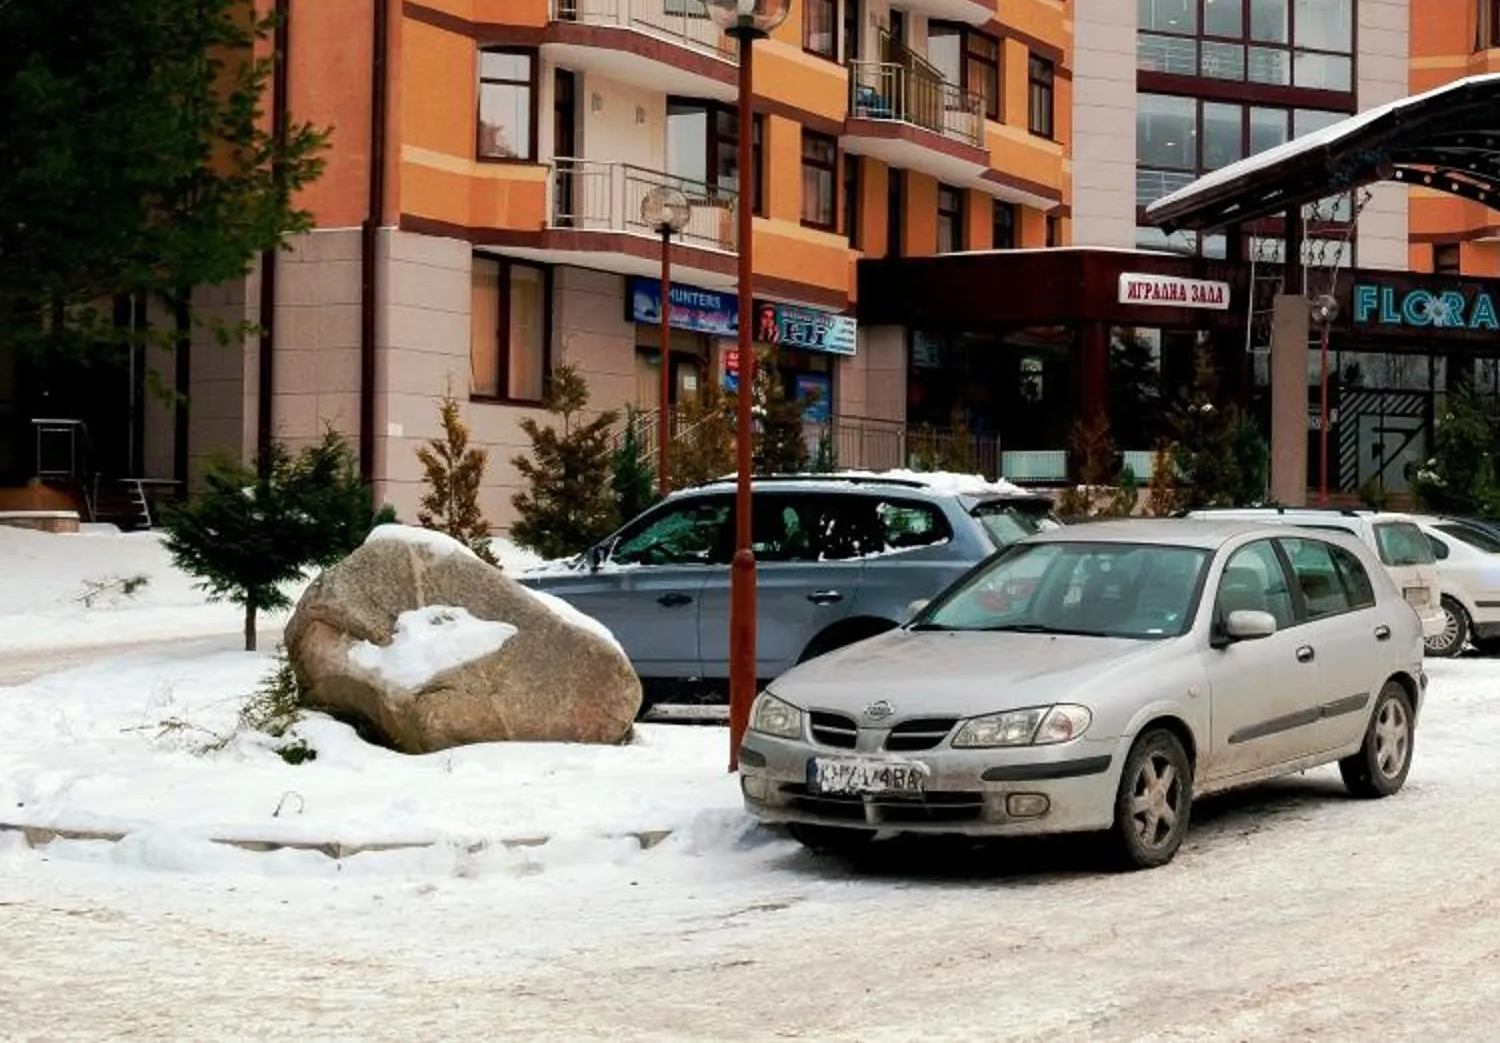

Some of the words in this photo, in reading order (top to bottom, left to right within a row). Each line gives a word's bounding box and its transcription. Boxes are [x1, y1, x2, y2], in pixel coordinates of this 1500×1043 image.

[1127, 280, 1187, 302] ИГРАЛНА
[1191, 284, 1223, 304] ЗАЛА
[1354, 284, 1500, 330] FLORA
